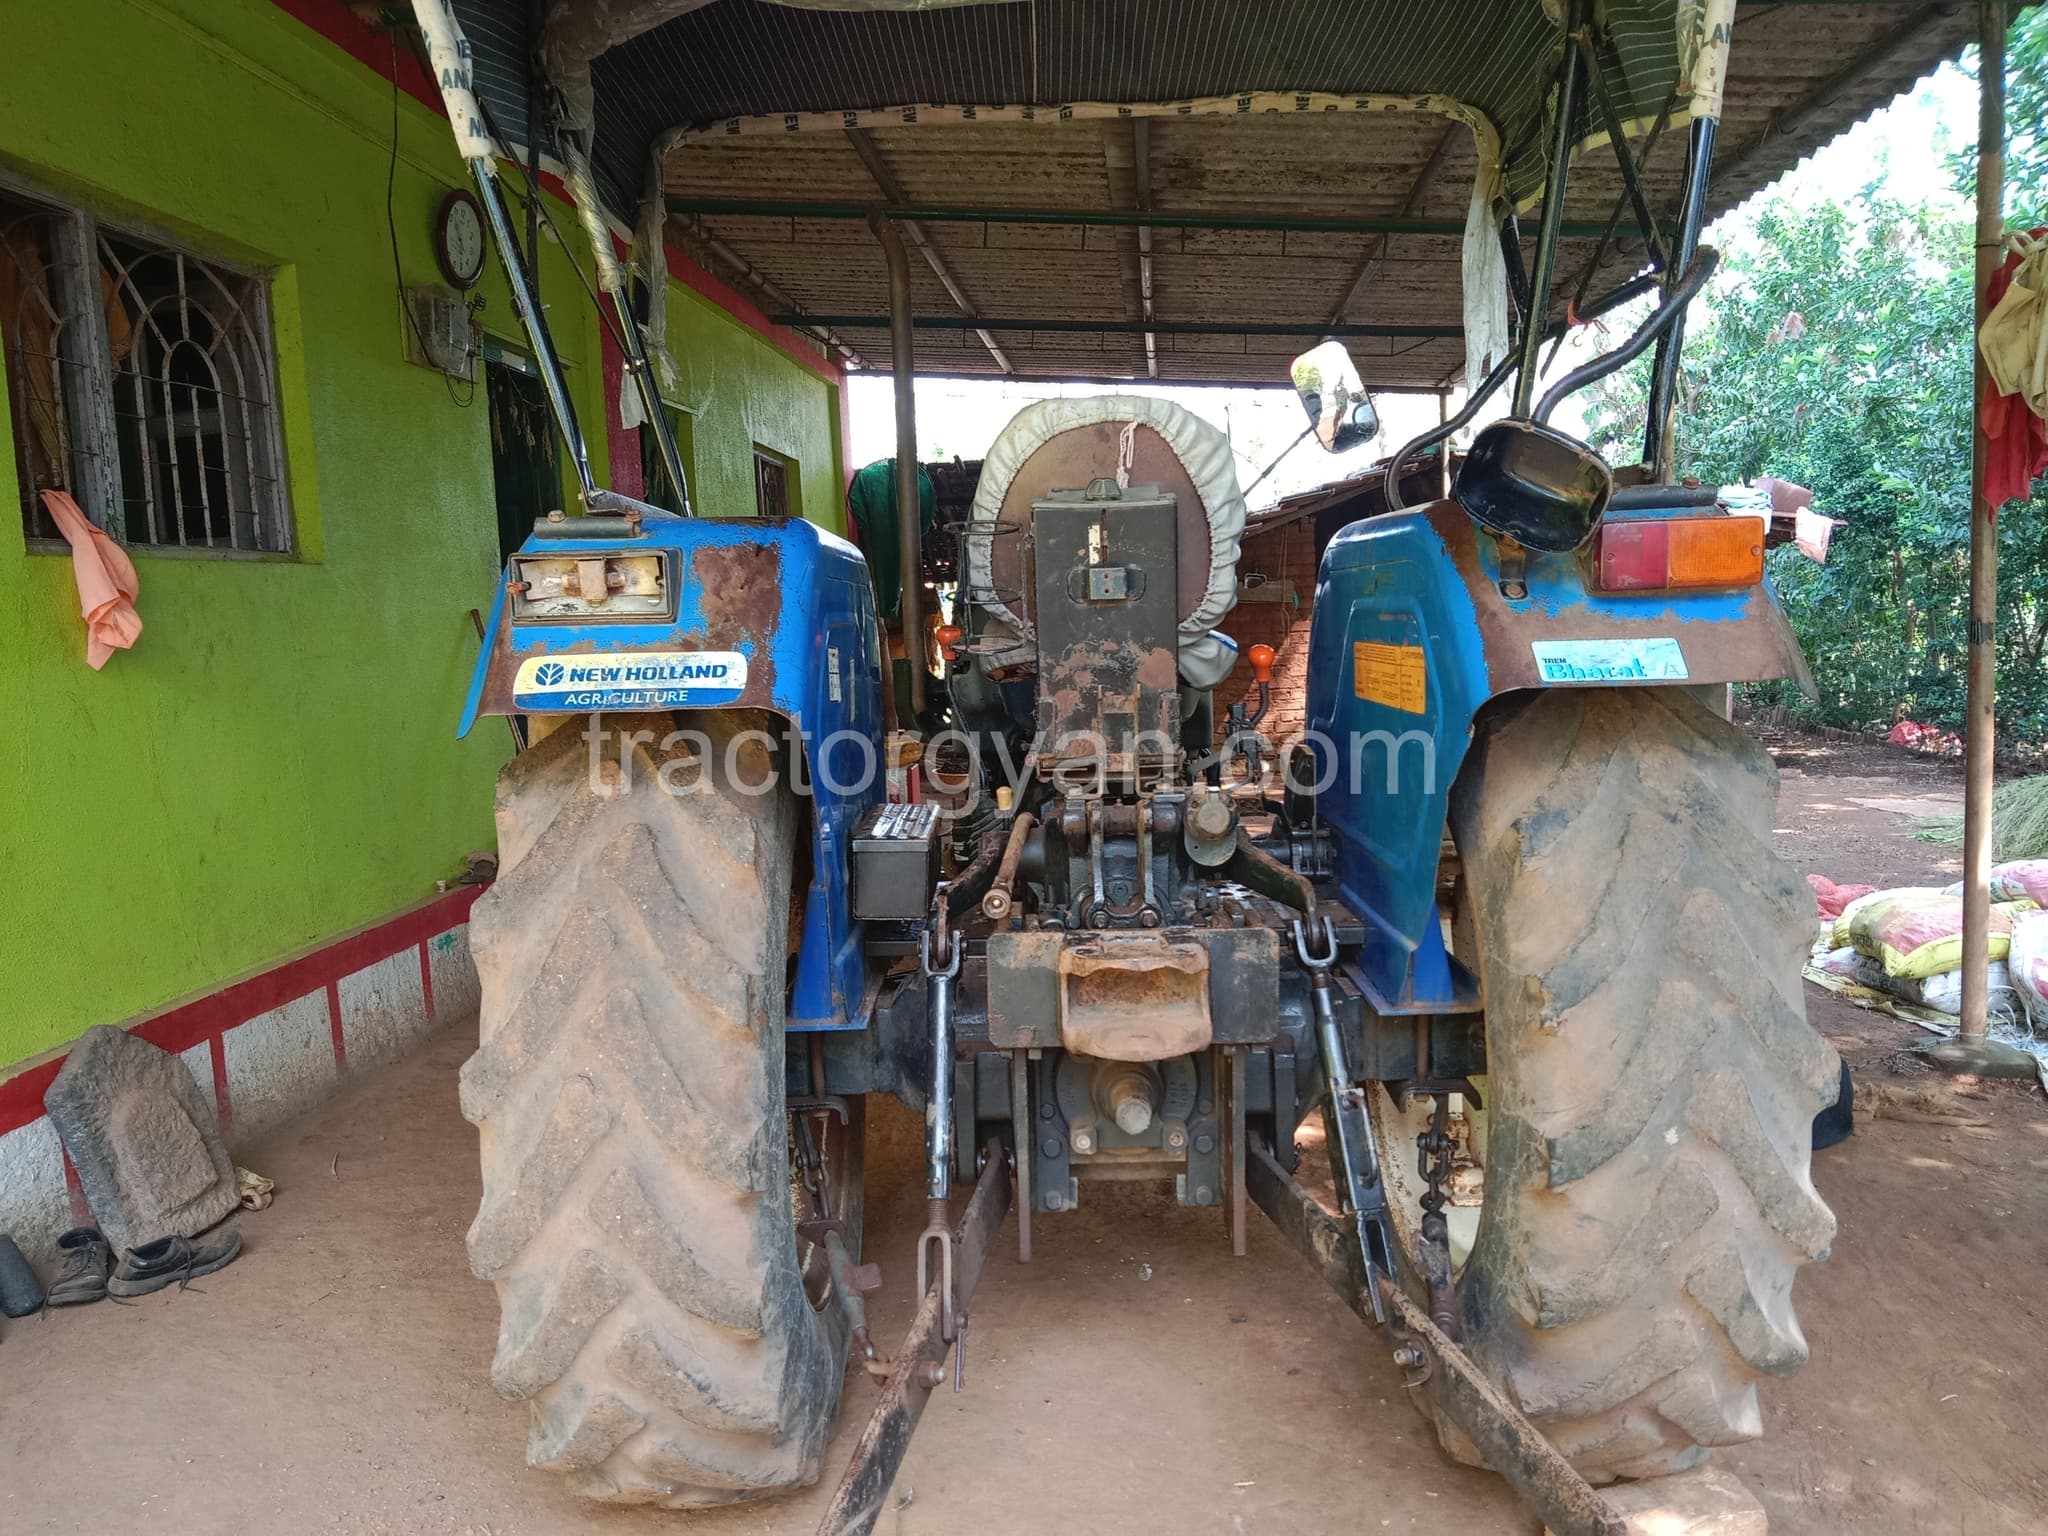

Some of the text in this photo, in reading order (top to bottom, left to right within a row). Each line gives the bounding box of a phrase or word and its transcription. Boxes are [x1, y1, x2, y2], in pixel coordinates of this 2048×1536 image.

[569, 664, 728, 682] NEW HOLLAND
[1544, 658, 1648, 679] Bharat
[565, 690, 689, 705] AGRICULTURE
